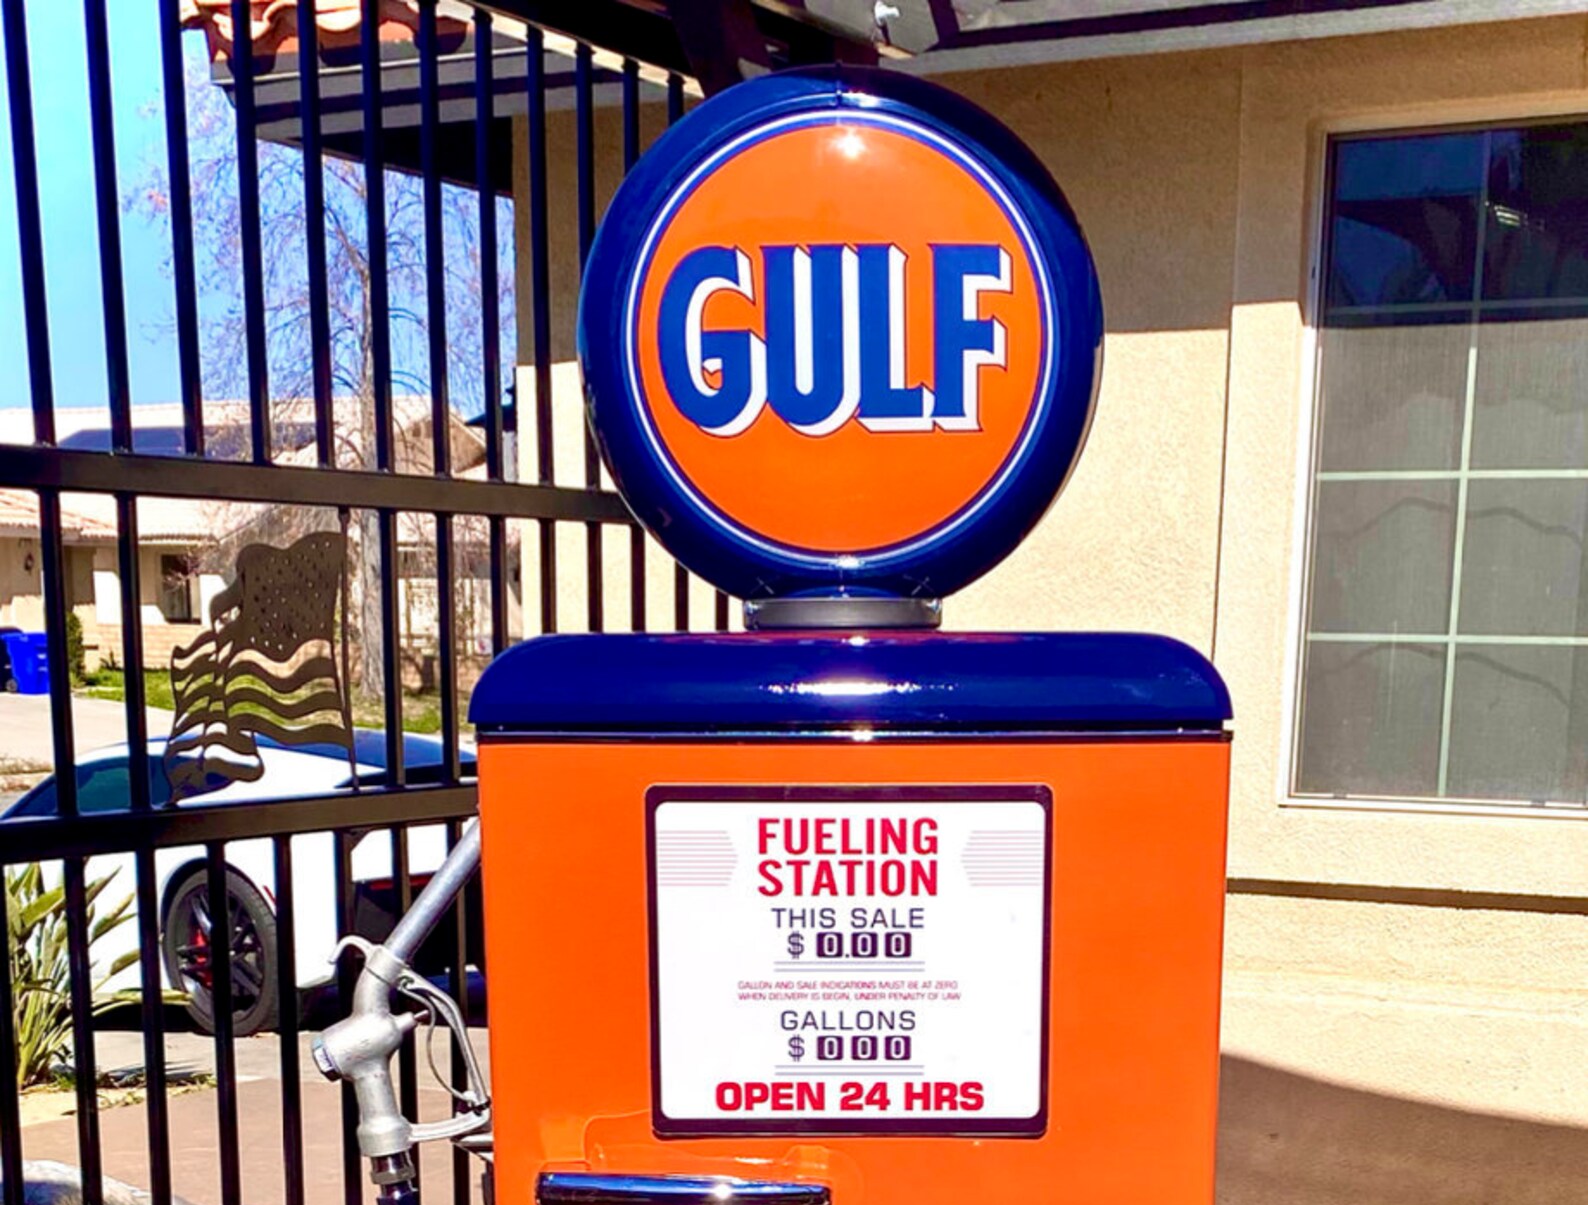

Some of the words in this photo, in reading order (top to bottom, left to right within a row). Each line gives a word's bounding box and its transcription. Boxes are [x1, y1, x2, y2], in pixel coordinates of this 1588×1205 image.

[657, 242, 1014, 438] GULF
[757, 817, 939, 856] FUELING
[757, 859, 939, 898] STATION
[771, 907, 837, 930] THIS
[850, 907, 926, 930] SALE
[738, 992, 766, 1001] WHEN
[768, 992, 809, 1001] DELIVERY
[855, 992, 886, 1001] UNDER
[888, 992, 925, 1001] PENALTY
[927, 992, 938, 1001] OF
[942, 992, 961, 1001] LAW
[774, 980, 794, 990] AND
[796, 980, 817, 990] SALE
[878, 980, 905, 990] MUST
[907, 980, 919, 990] BE
[921, 980, 932, 990] AT
[935, 980, 958, 990] ZERO
[780, 1010, 916, 1031] GALLONS
[715, 1082, 826, 1111] OPEN
[839, 1082, 890, 1111] 24
[904, 1082, 985, 1111] HRS
